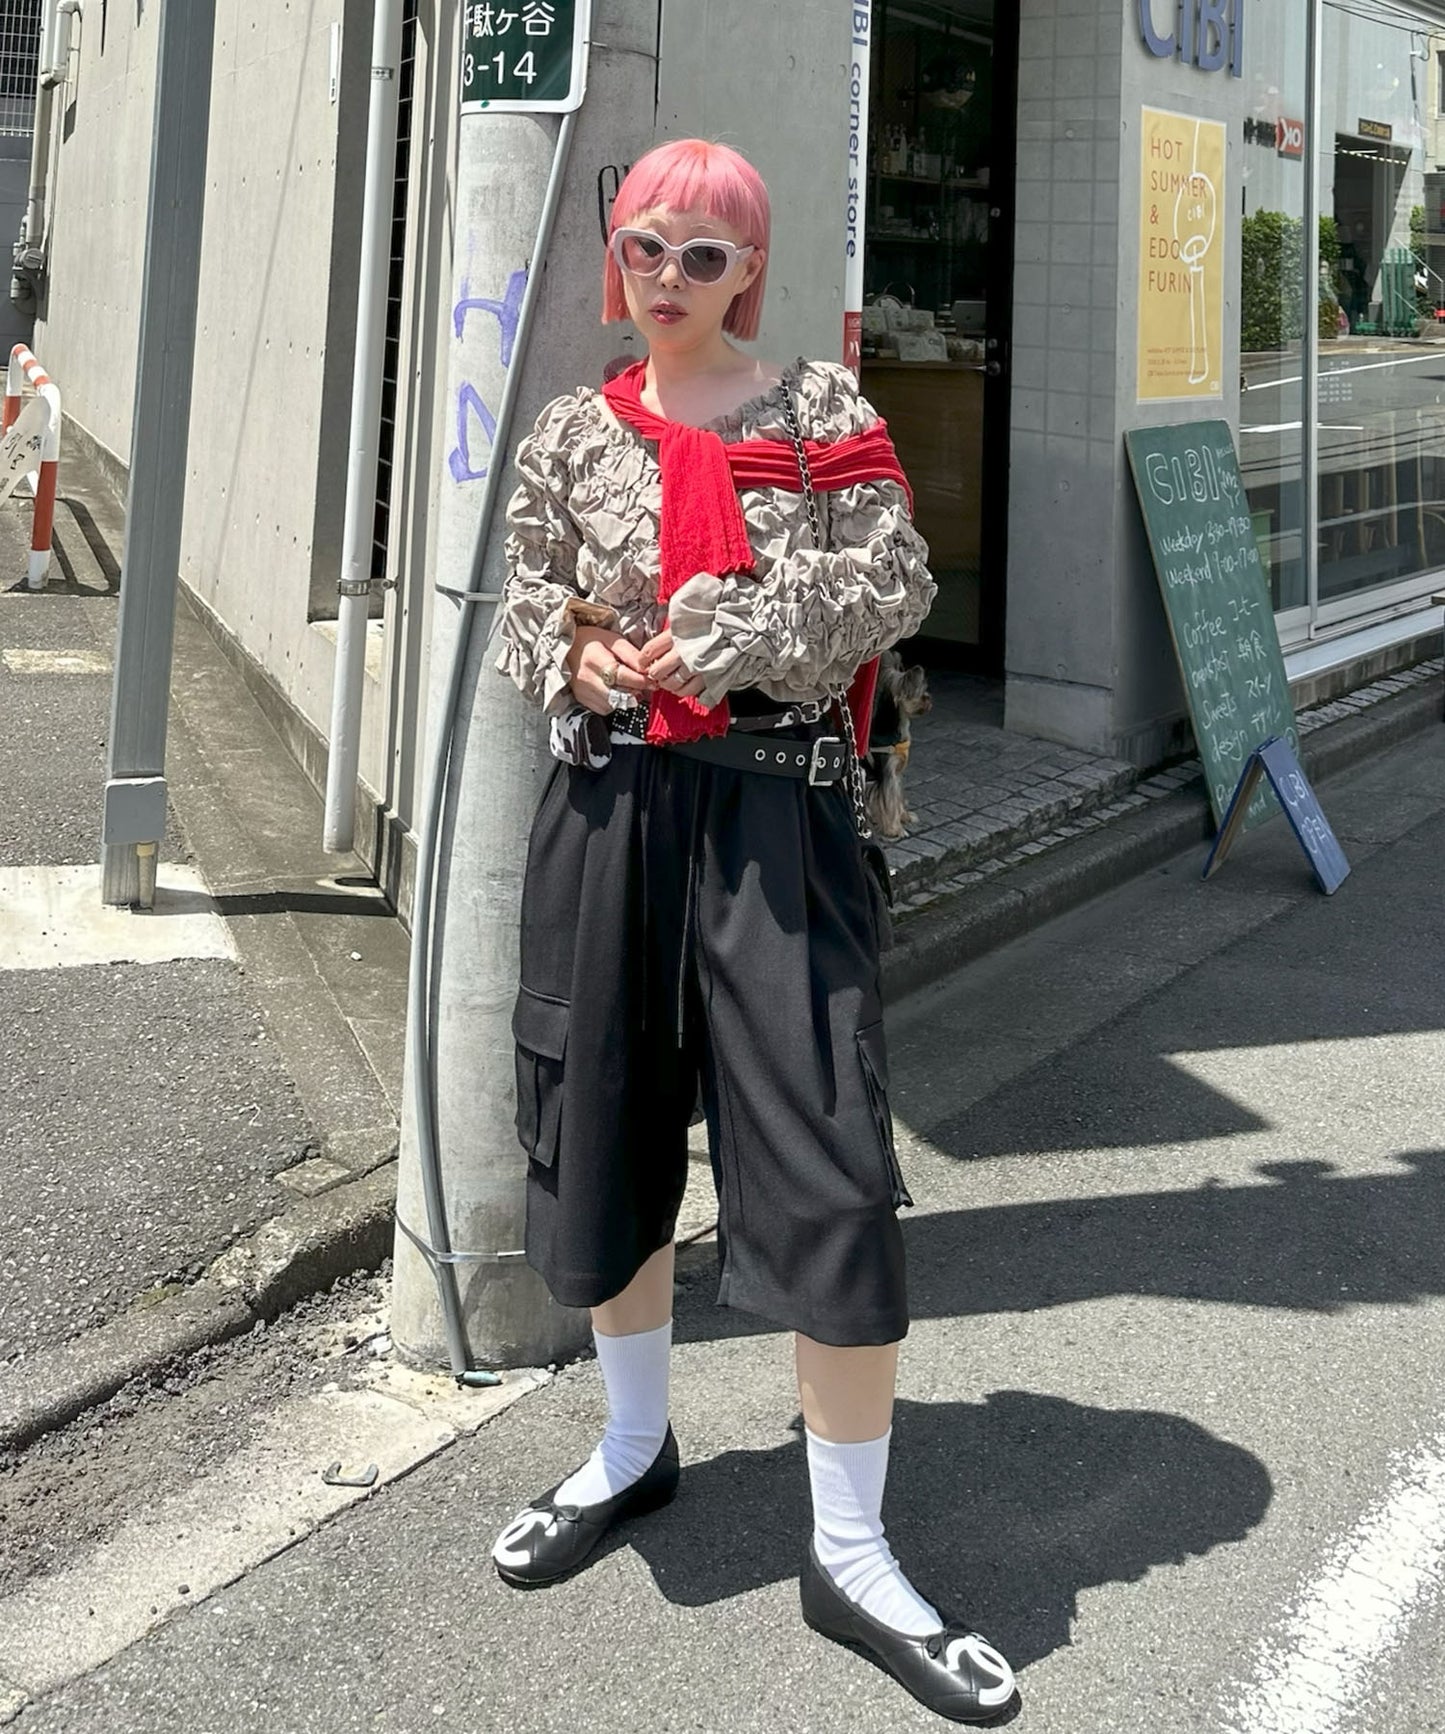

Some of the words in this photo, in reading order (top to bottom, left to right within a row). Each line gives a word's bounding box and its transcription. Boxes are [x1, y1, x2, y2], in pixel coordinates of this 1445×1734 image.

[1141, 0, 1243, 78] CIBI
[464, 51, 537, 86] 3-14
[850, 62, 861, 166] corner
[1150, 138, 1183, 162] HOT
[1151, 170, 1207, 198] SUMMER
[846, 177, 859, 258] store
[1150, 204, 1159, 225] &
[1149, 237, 1181, 260] EDO
[1148, 270, 1192, 294] FURIN
[1145, 445, 1219, 505] CIBI
[1184, 609, 1227, 648] Coffee
